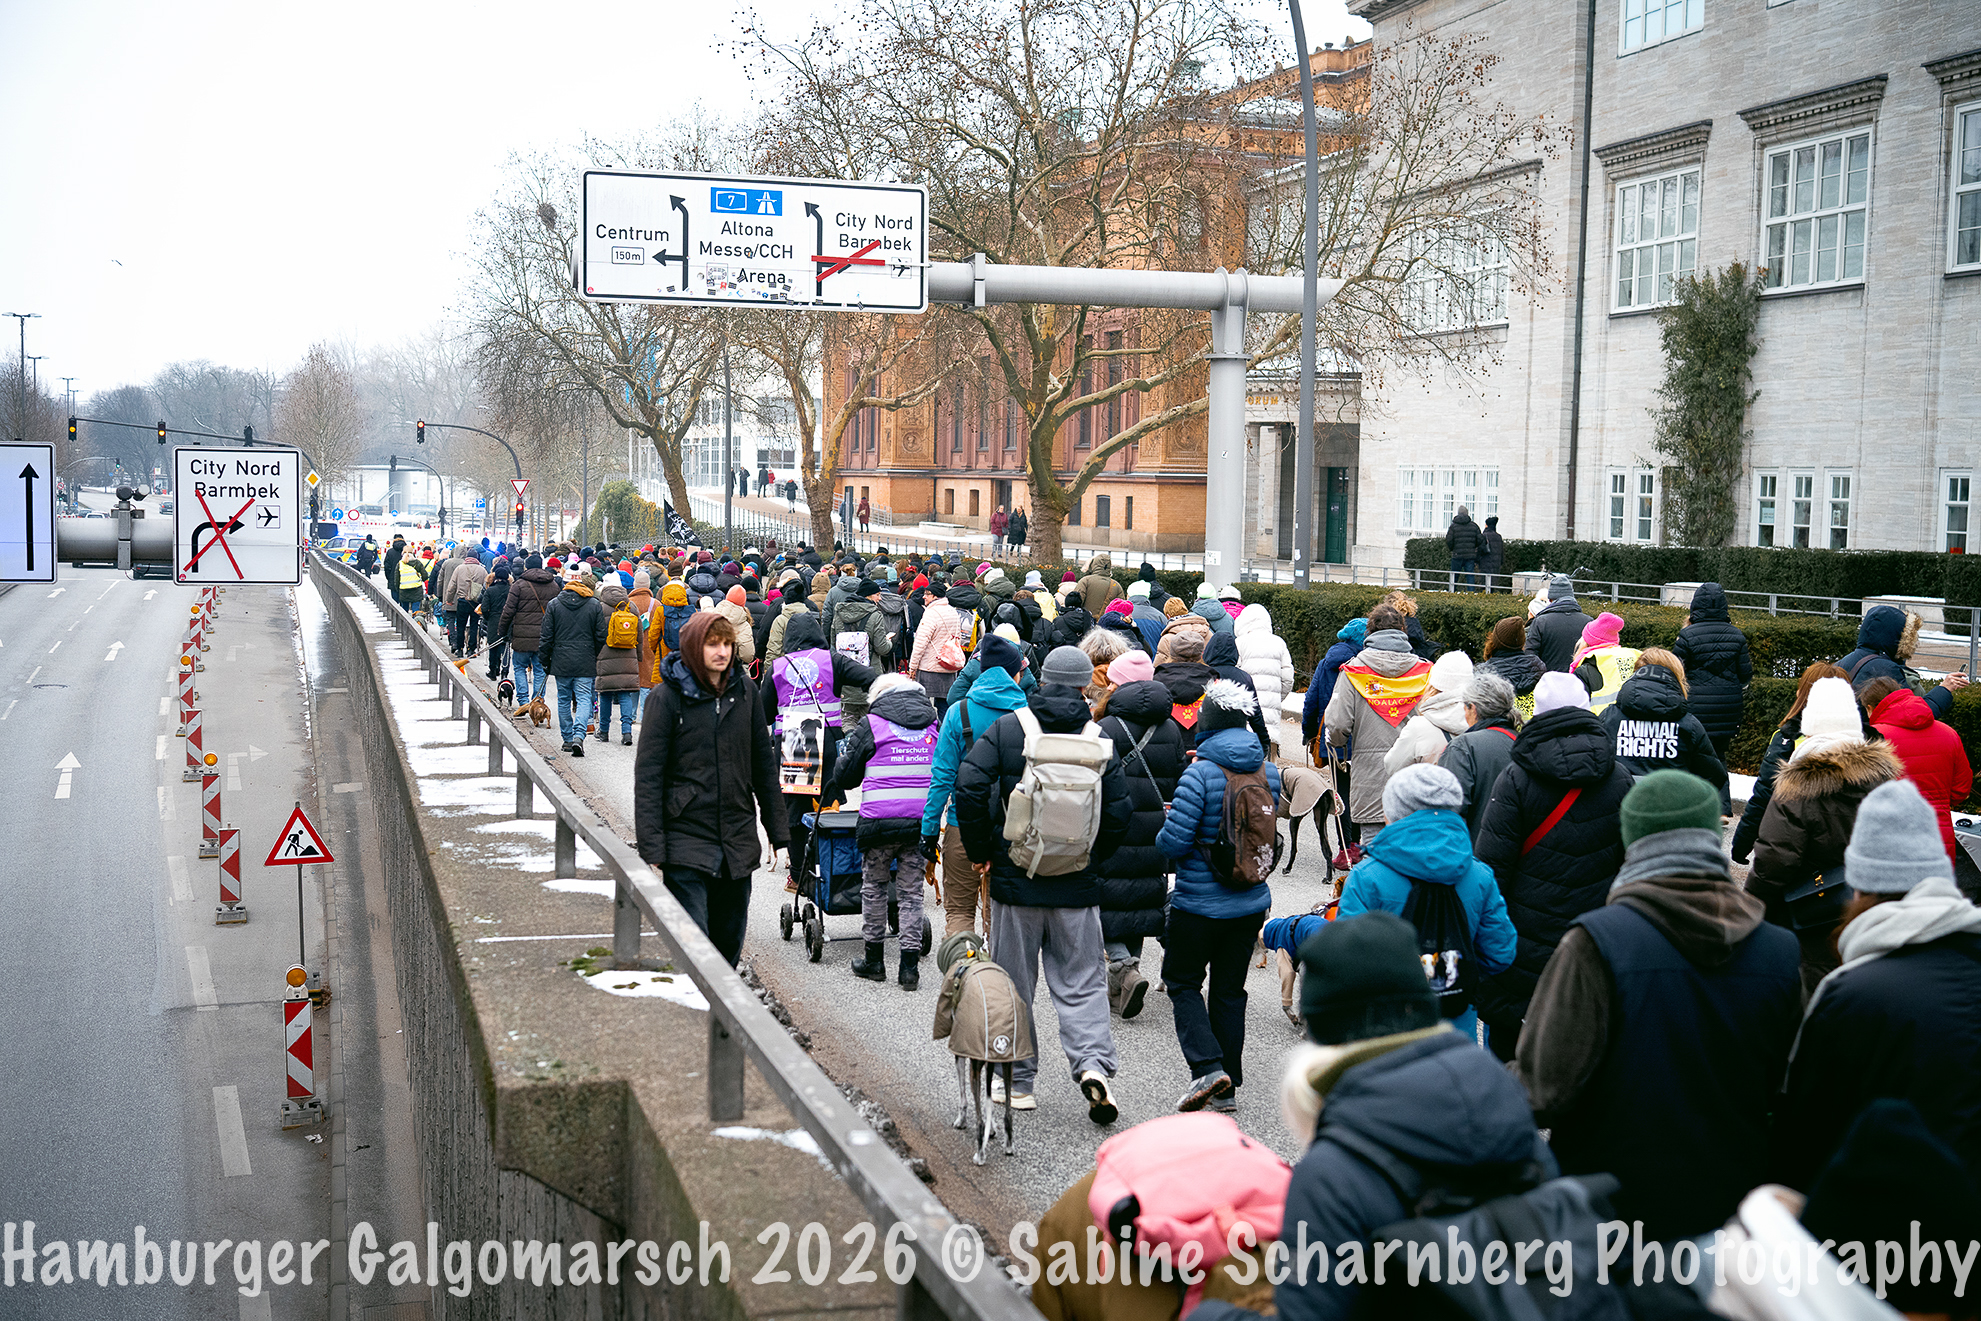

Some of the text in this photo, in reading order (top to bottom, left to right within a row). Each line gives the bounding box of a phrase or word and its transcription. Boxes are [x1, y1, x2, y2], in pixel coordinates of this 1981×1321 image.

[726, 194, 735, 208] 7
[720, 221, 774, 238] Altona
[835, 212, 913, 231] City Nord
[596, 224, 670, 242] Centrum
[839, 233, 912, 251] Barmbek
[699, 241, 794, 260] Messe/CCH
[738, 268, 786, 284] Arena
[1247, 396, 1278, 405] ORUM
[190, 459, 281, 479] City Nord
[194, 482, 280, 499] Barmbek
[1616, 719, 1679, 740] ANIMAL
[1616, 736, 1678, 759] RIGHTS
